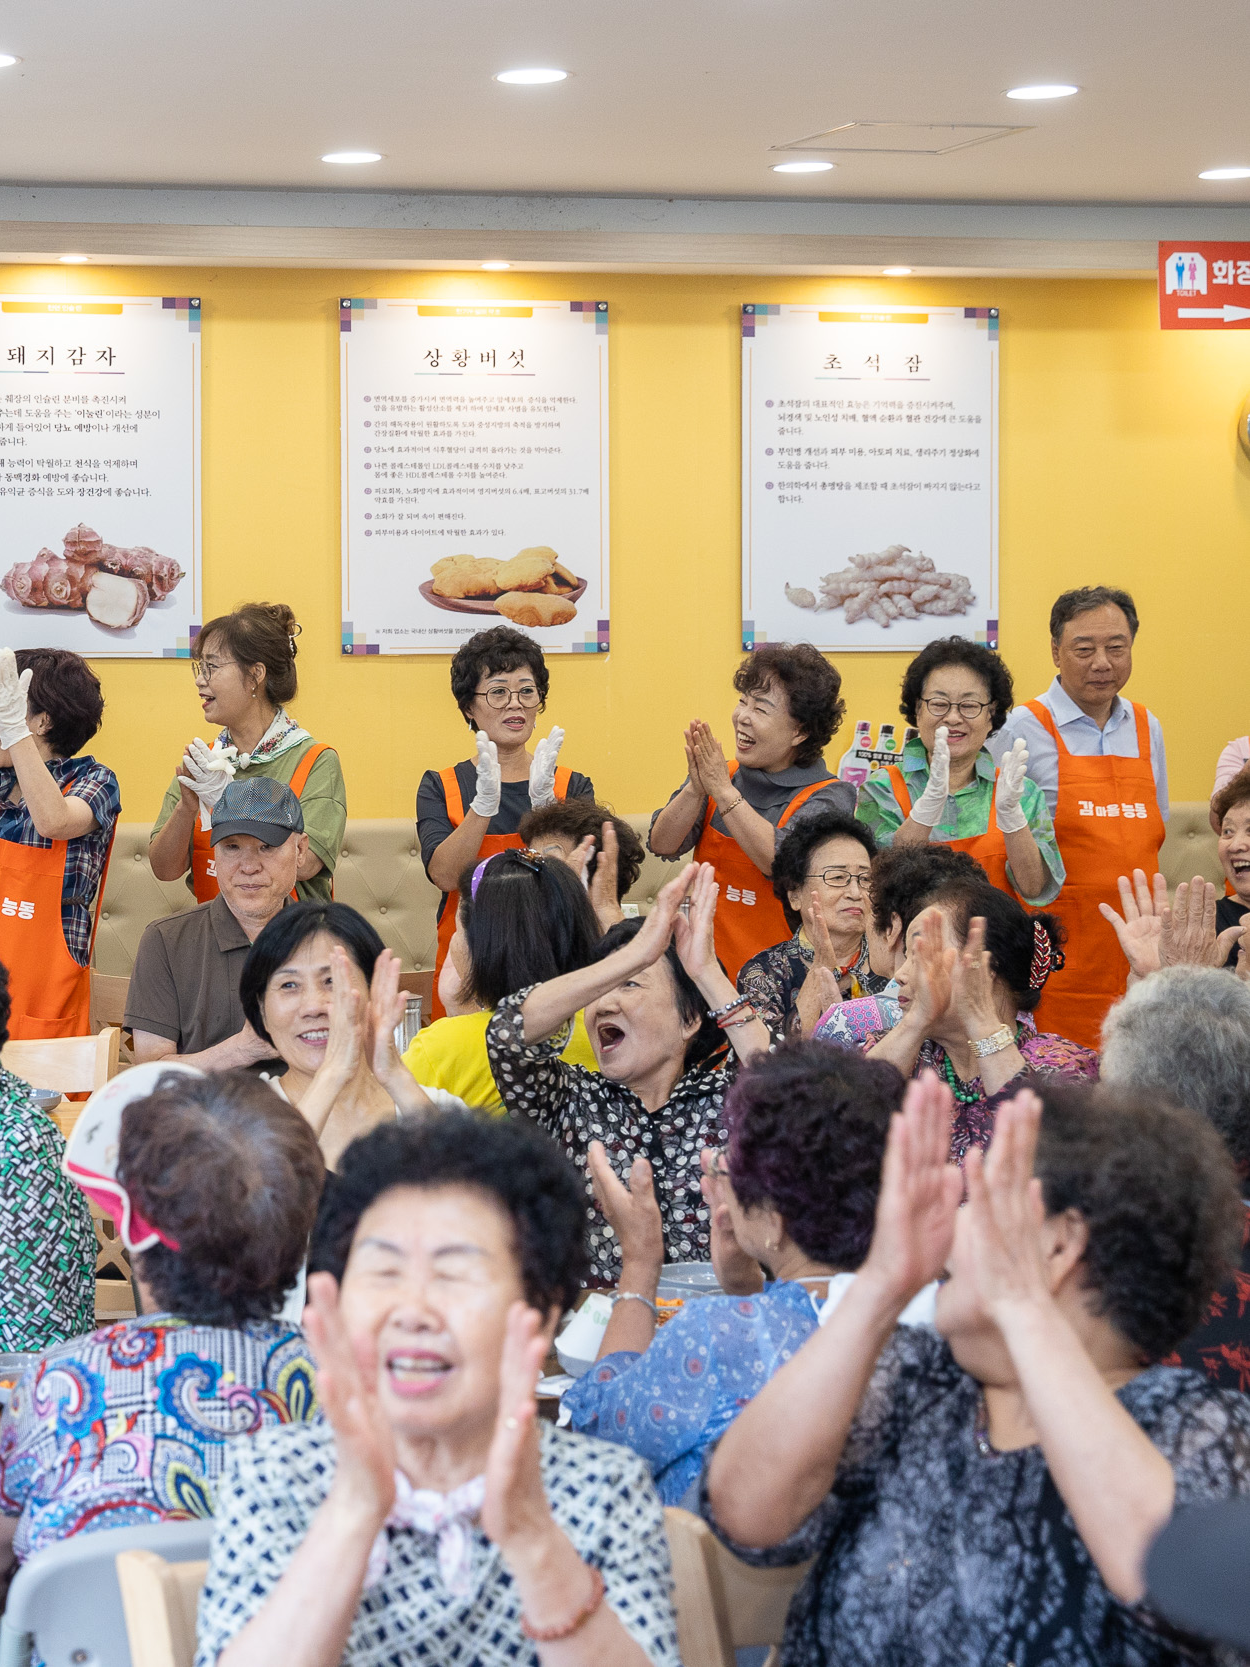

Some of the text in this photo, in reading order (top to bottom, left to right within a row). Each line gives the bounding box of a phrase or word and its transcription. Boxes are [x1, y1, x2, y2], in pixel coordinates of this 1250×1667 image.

[1121, 802, 1148, 819] 능동
[726, 885, 756, 906] 능동
[1, 897, 35, 920] 능동
